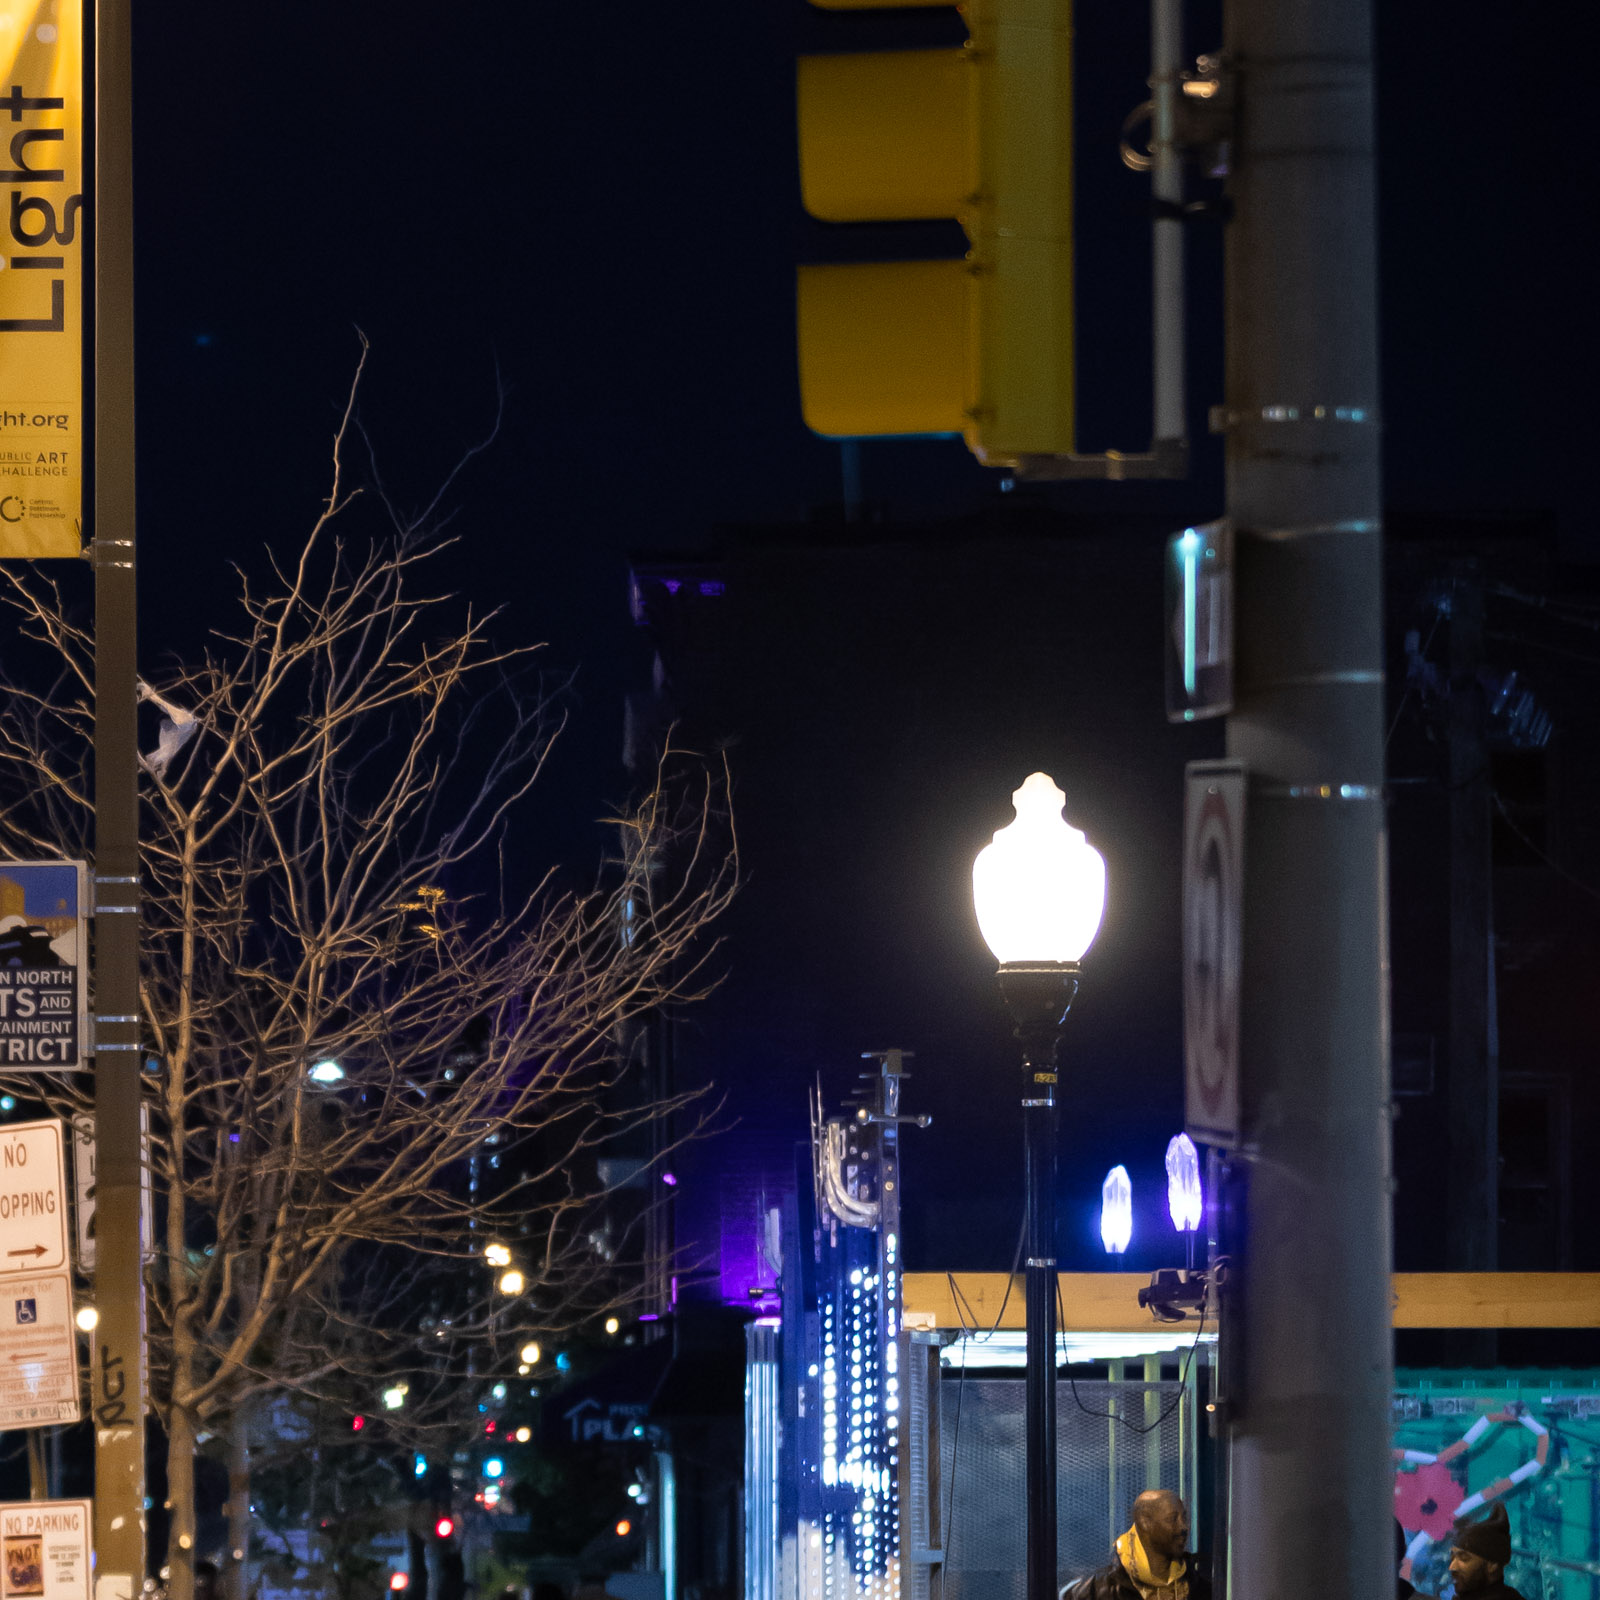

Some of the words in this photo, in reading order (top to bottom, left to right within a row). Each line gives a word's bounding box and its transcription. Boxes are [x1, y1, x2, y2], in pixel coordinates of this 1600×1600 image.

[36, 451, 69, 464] ART
[16, 970, 72, 985] NORTH
[39, 996, 71, 1009] AND
[4, 1143, 27, 1168] NO
[5, 1517, 22, 1534] NO
[26, 1513, 79, 1533] PARKING
